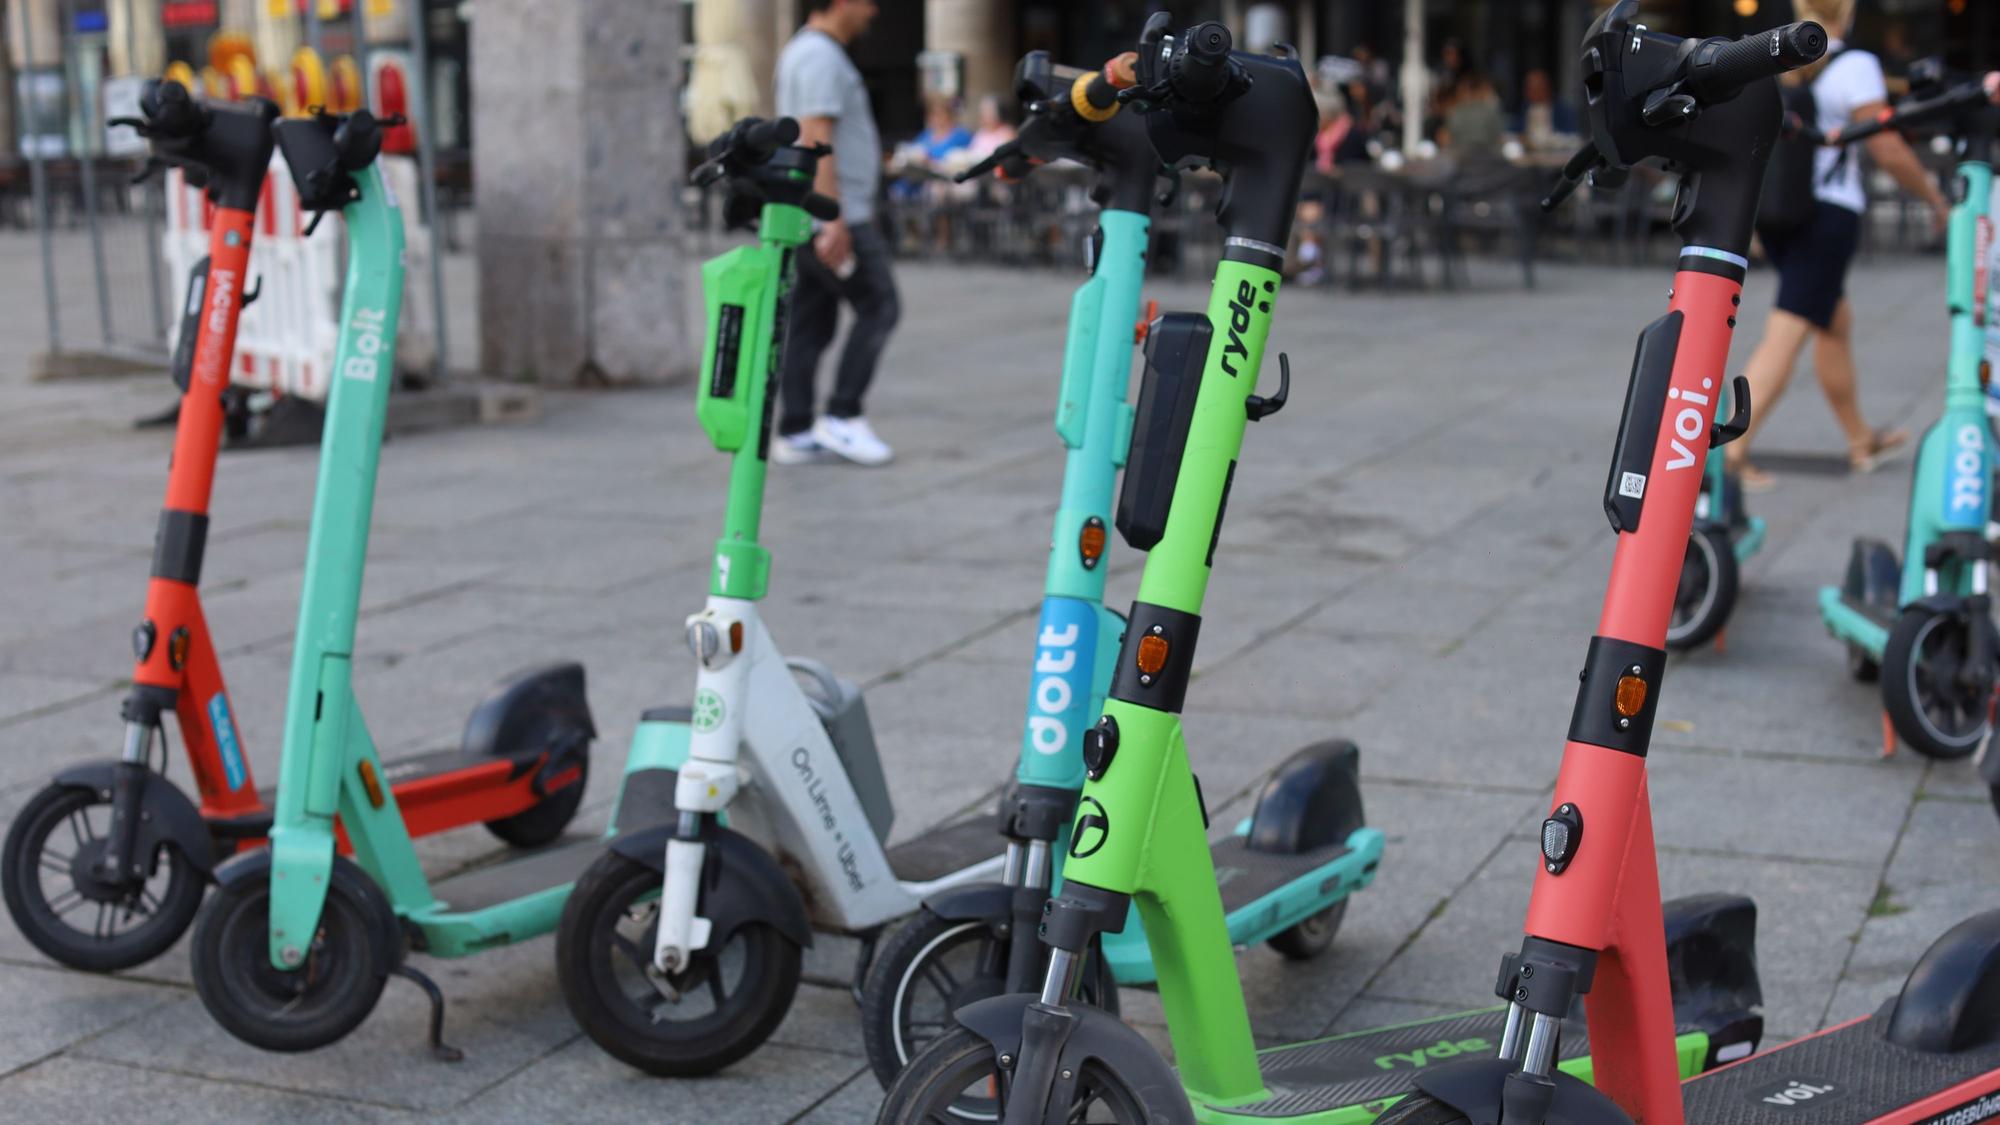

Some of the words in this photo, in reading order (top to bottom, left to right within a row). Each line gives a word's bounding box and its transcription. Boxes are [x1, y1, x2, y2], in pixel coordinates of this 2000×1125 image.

[344, 308, 390, 382] Bolt
[1221, 279, 1257, 378] ryde
[1655, 377, 1713, 472] voi.
[1953, 424, 1984, 510] dott
[1029, 623, 1079, 756] dott
[791, 747, 814, 783] On
[807, 778, 836, 831] Lime
[837, 841, 865, 892] Uber
[1374, 1038, 1492, 1069] ryde
[1762, 1080, 1834, 1105] voi.
